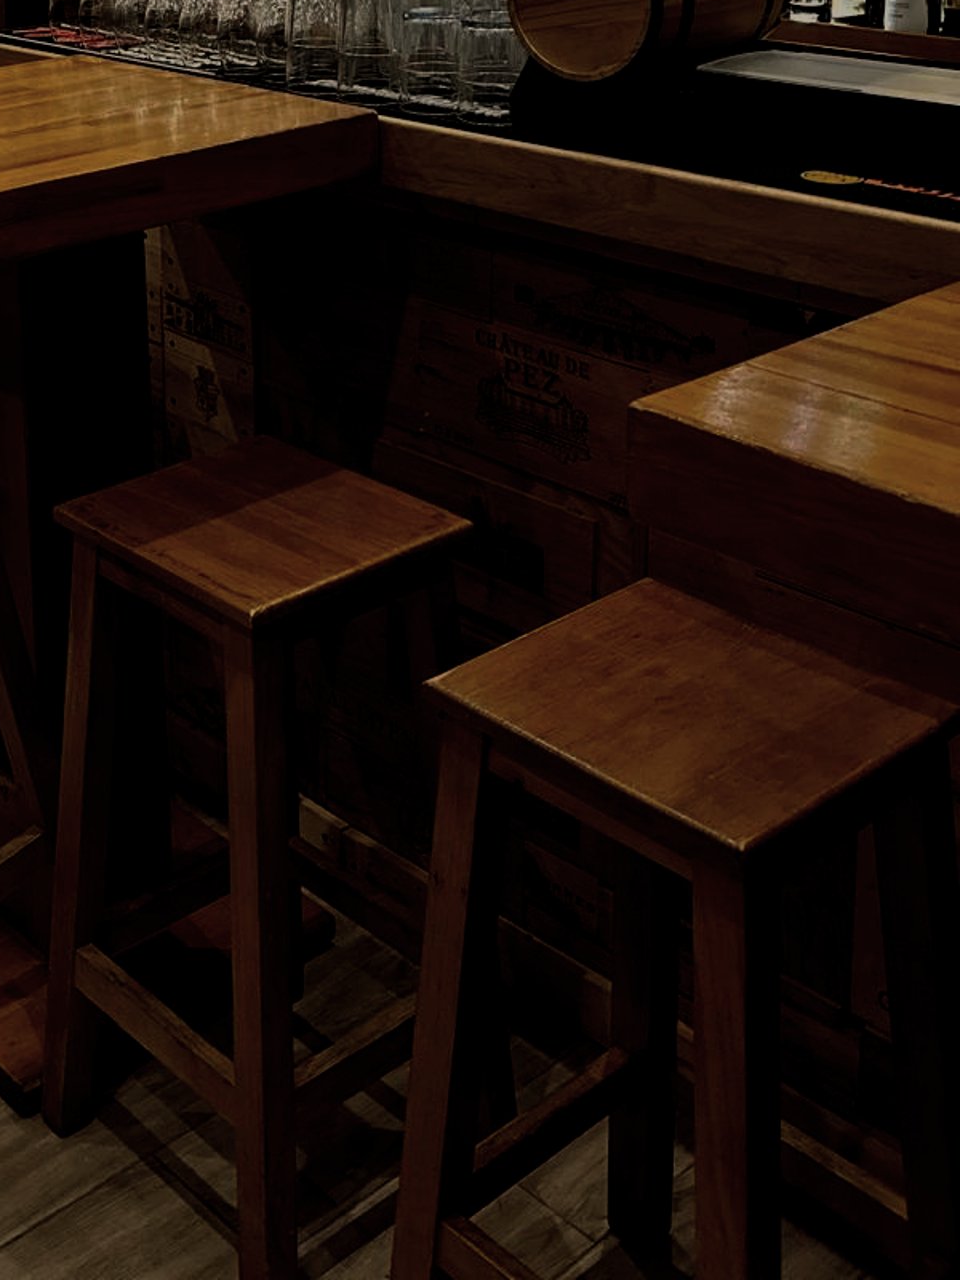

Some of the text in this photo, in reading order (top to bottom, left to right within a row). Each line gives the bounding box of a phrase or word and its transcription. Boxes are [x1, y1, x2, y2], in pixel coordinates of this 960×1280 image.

[476, 327, 591, 380] CHÂTEAU DE
[504, 358, 562, 397] PEZ
